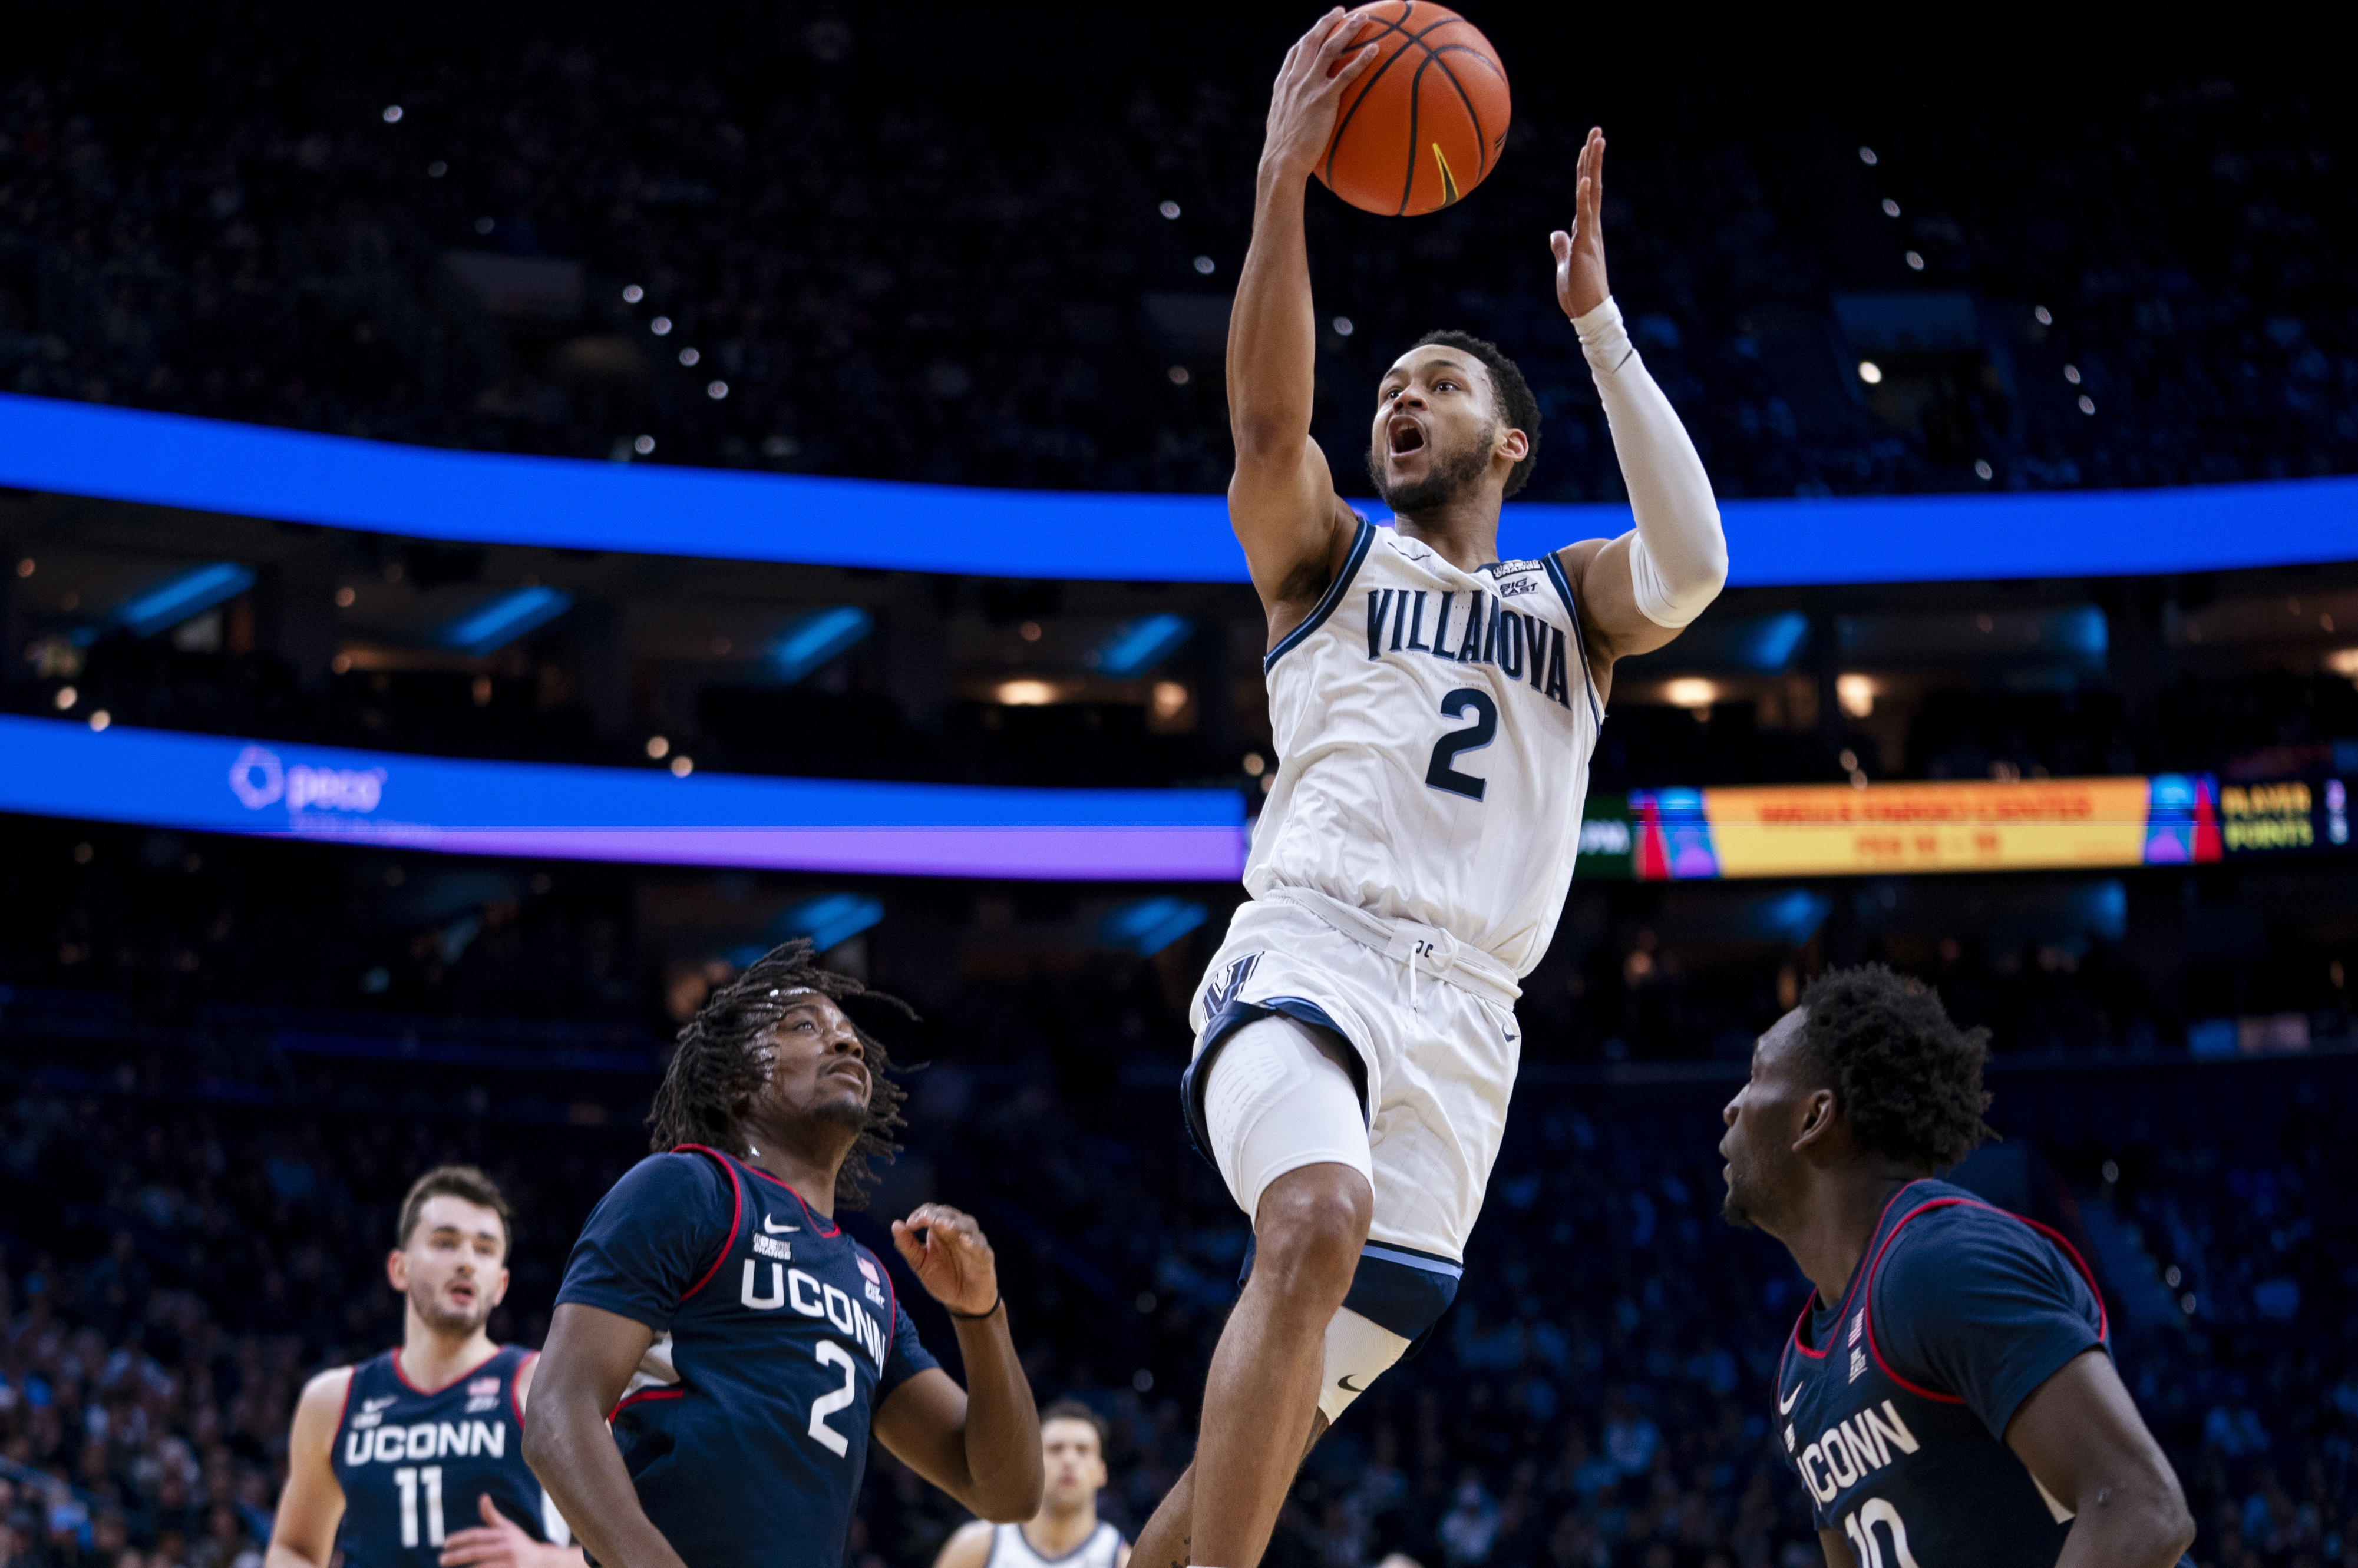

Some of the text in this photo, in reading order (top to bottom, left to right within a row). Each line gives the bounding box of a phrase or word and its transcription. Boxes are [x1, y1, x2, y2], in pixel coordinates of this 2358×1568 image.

[1500, 577, 1528, 590] BIG
[1501, 583, 1538, 597] EAST
[1366, 588, 1572, 711] VILLANOVA
[1425, 687, 1498, 803] 2
[1758, 793, 2092, 823] WELLS FARGO CENTER
[2221, 784, 2312, 817] PLAYER
[2224, 820, 2314, 851] POINTS
[741, 1258, 886, 1381] UCONN
[808, 1339, 856, 1459] 2
[345, 1420, 506, 1467] UCONN
[394, 1464, 445, 1549] 11
